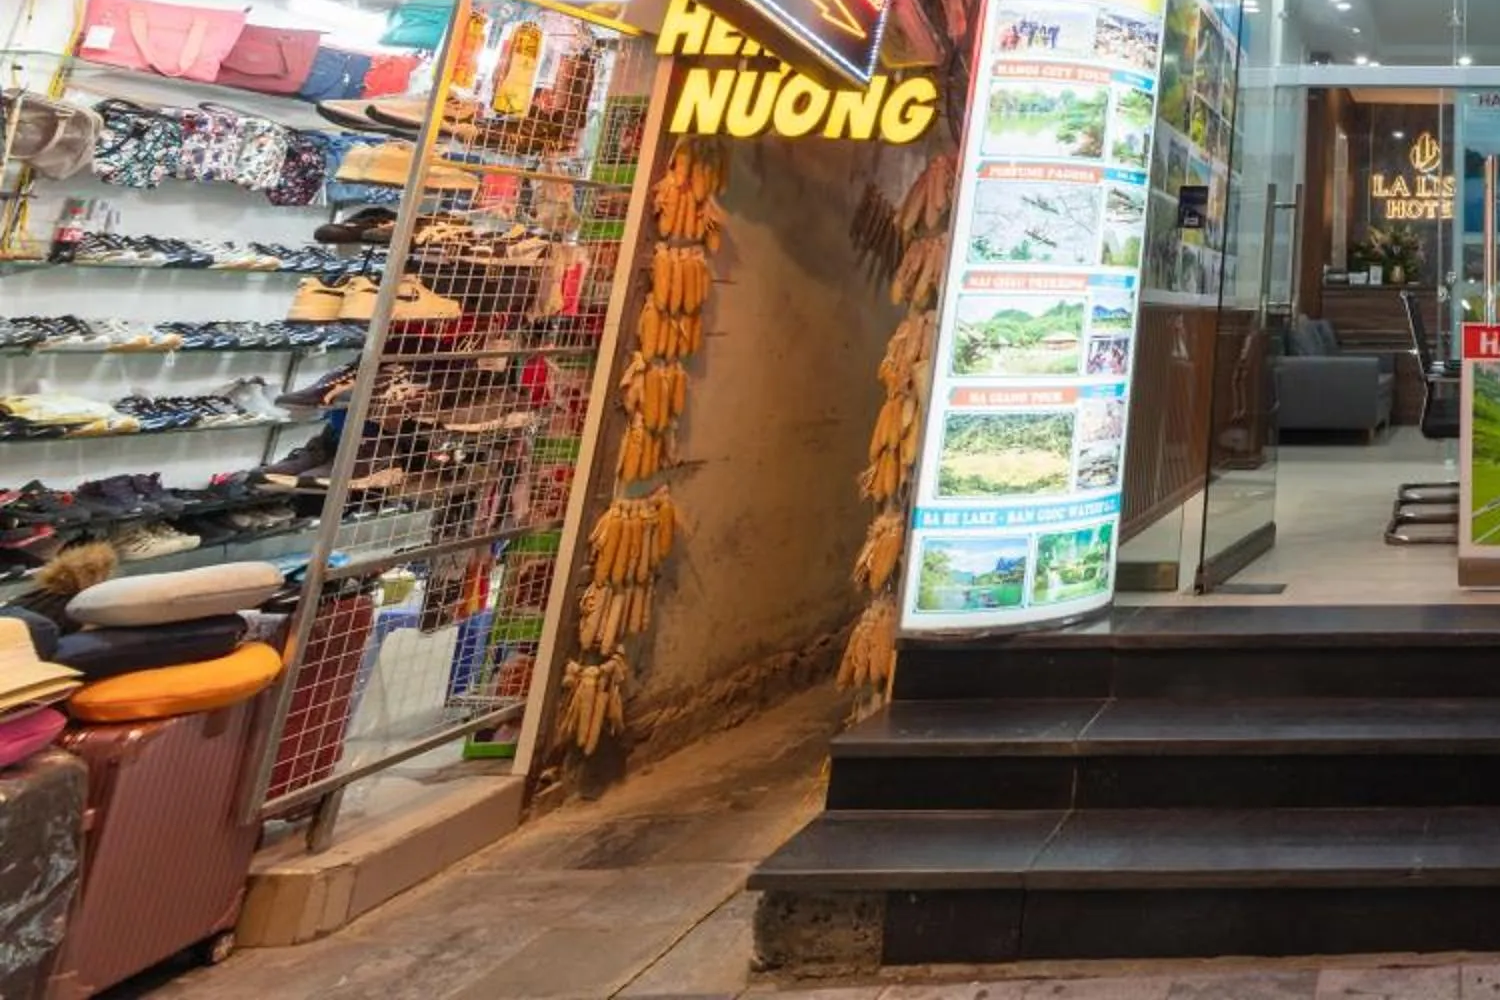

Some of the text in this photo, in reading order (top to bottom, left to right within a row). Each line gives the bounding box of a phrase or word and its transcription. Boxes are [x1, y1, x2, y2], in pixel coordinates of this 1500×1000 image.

[1477, 92, 1500, 107] HA
[1372, 173, 1457, 198] LA LIS
[1385, 200, 1456, 220] HOTE
